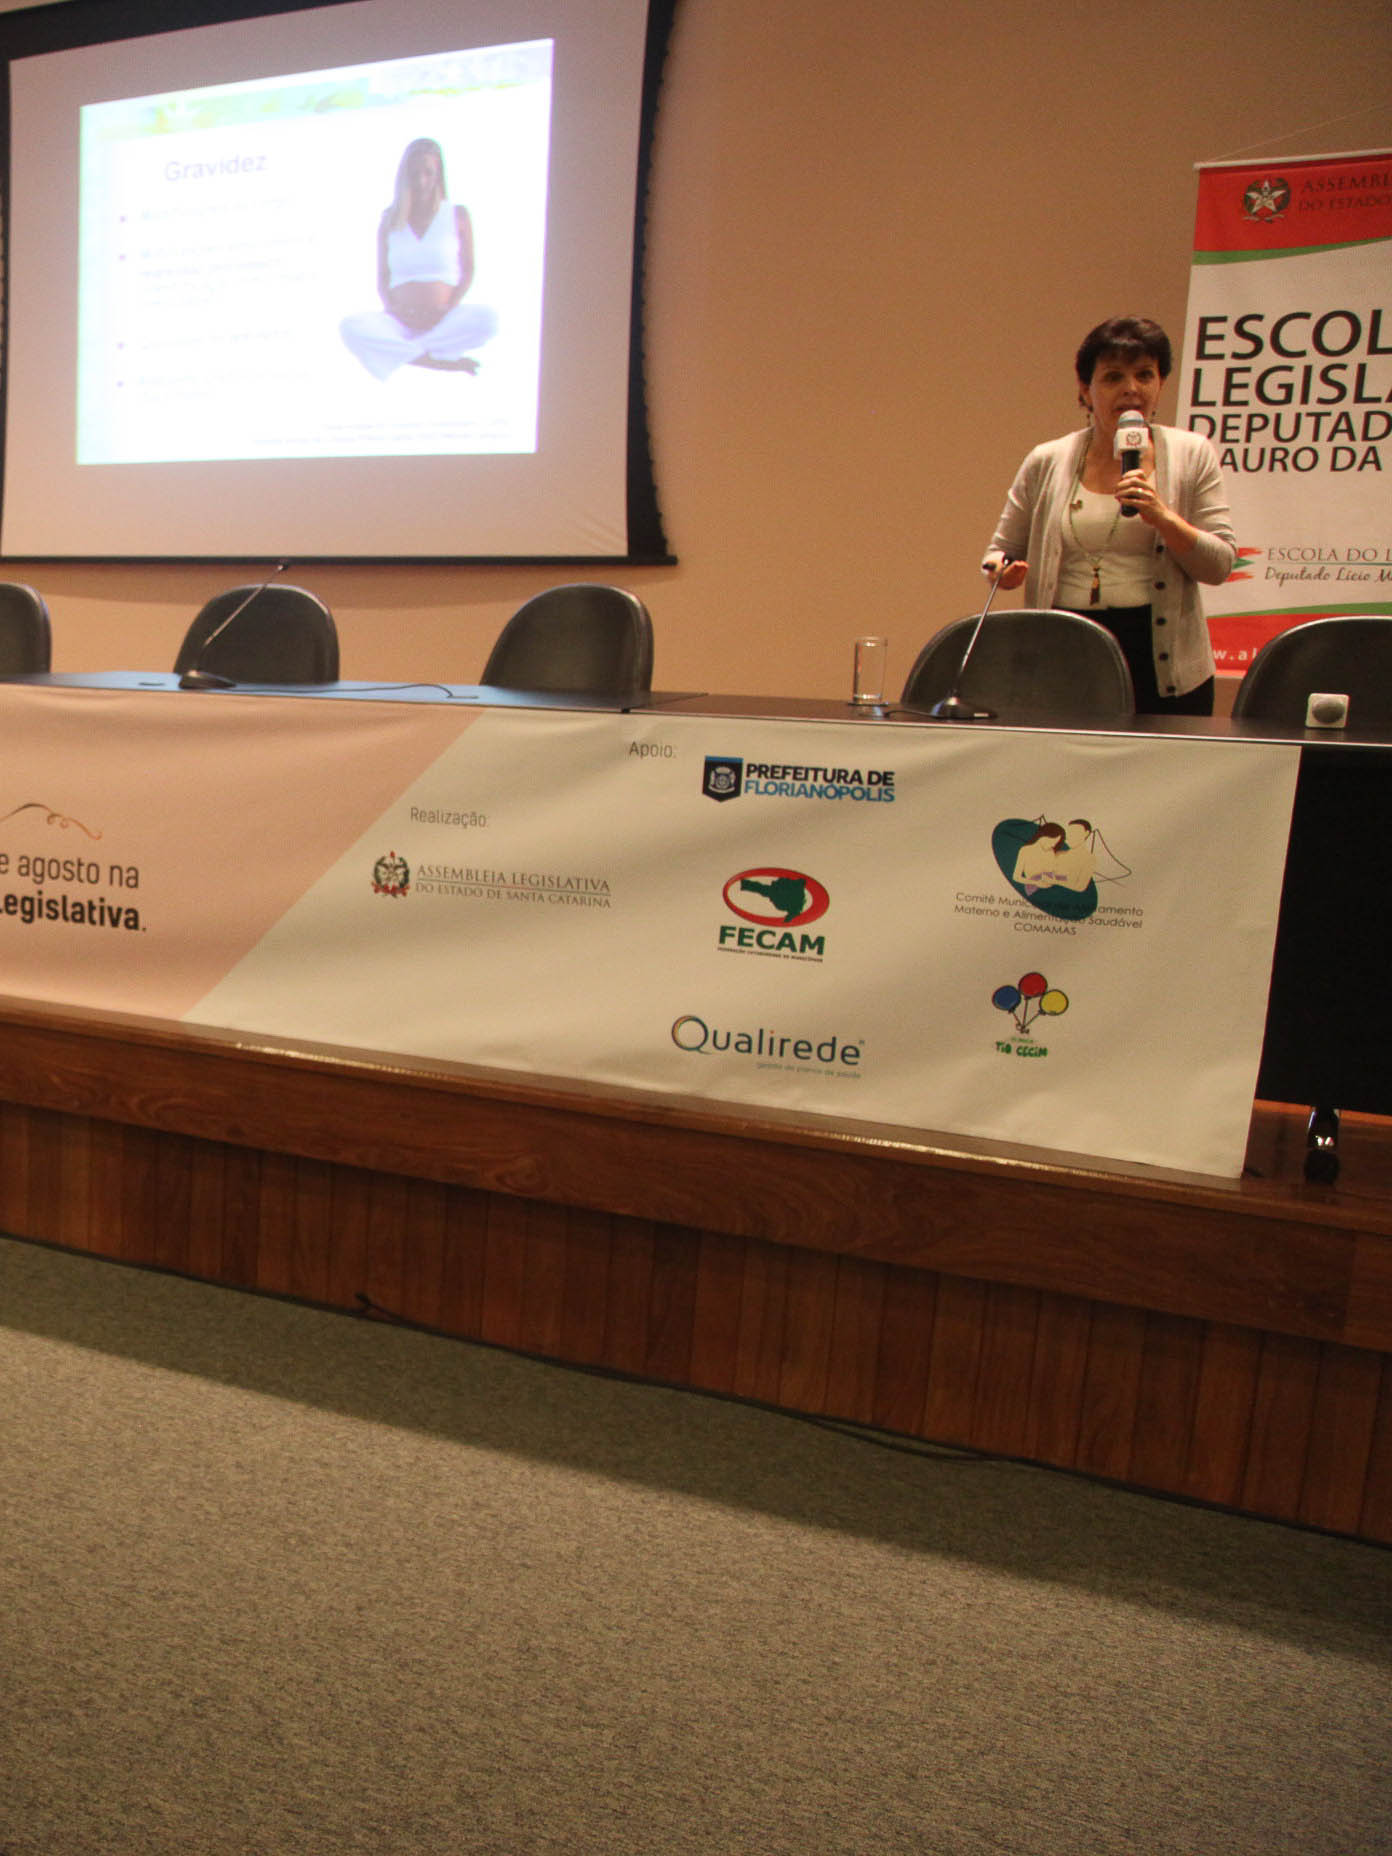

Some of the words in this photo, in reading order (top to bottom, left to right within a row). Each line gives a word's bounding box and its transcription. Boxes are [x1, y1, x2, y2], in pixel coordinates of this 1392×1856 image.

[164, 154, 268, 181] Gravidez
[1220, 446, 1319, 473] AURO
[1330, 446, 1382, 472] DA
[1266, 547, 1339, 561] ESCOLA
[1347, 547, 1378, 561] DO
[746, 763, 863, 786] PREFEITURA
[867, 771, 895, 787] DE
[744, 780, 896, 803] FLORIANÓPOLIS
[17, 854, 100, 885] agosto
[109, 864, 140, 889] na
[417, 864, 507, 884] ASSEMBLEIA
[512, 871, 611, 893] LEGISLATIVA
[954, 904, 1001, 918] Materno
[719, 925, 826, 956] FECAM
[1013, 921, 1077, 936] COMAMAS
